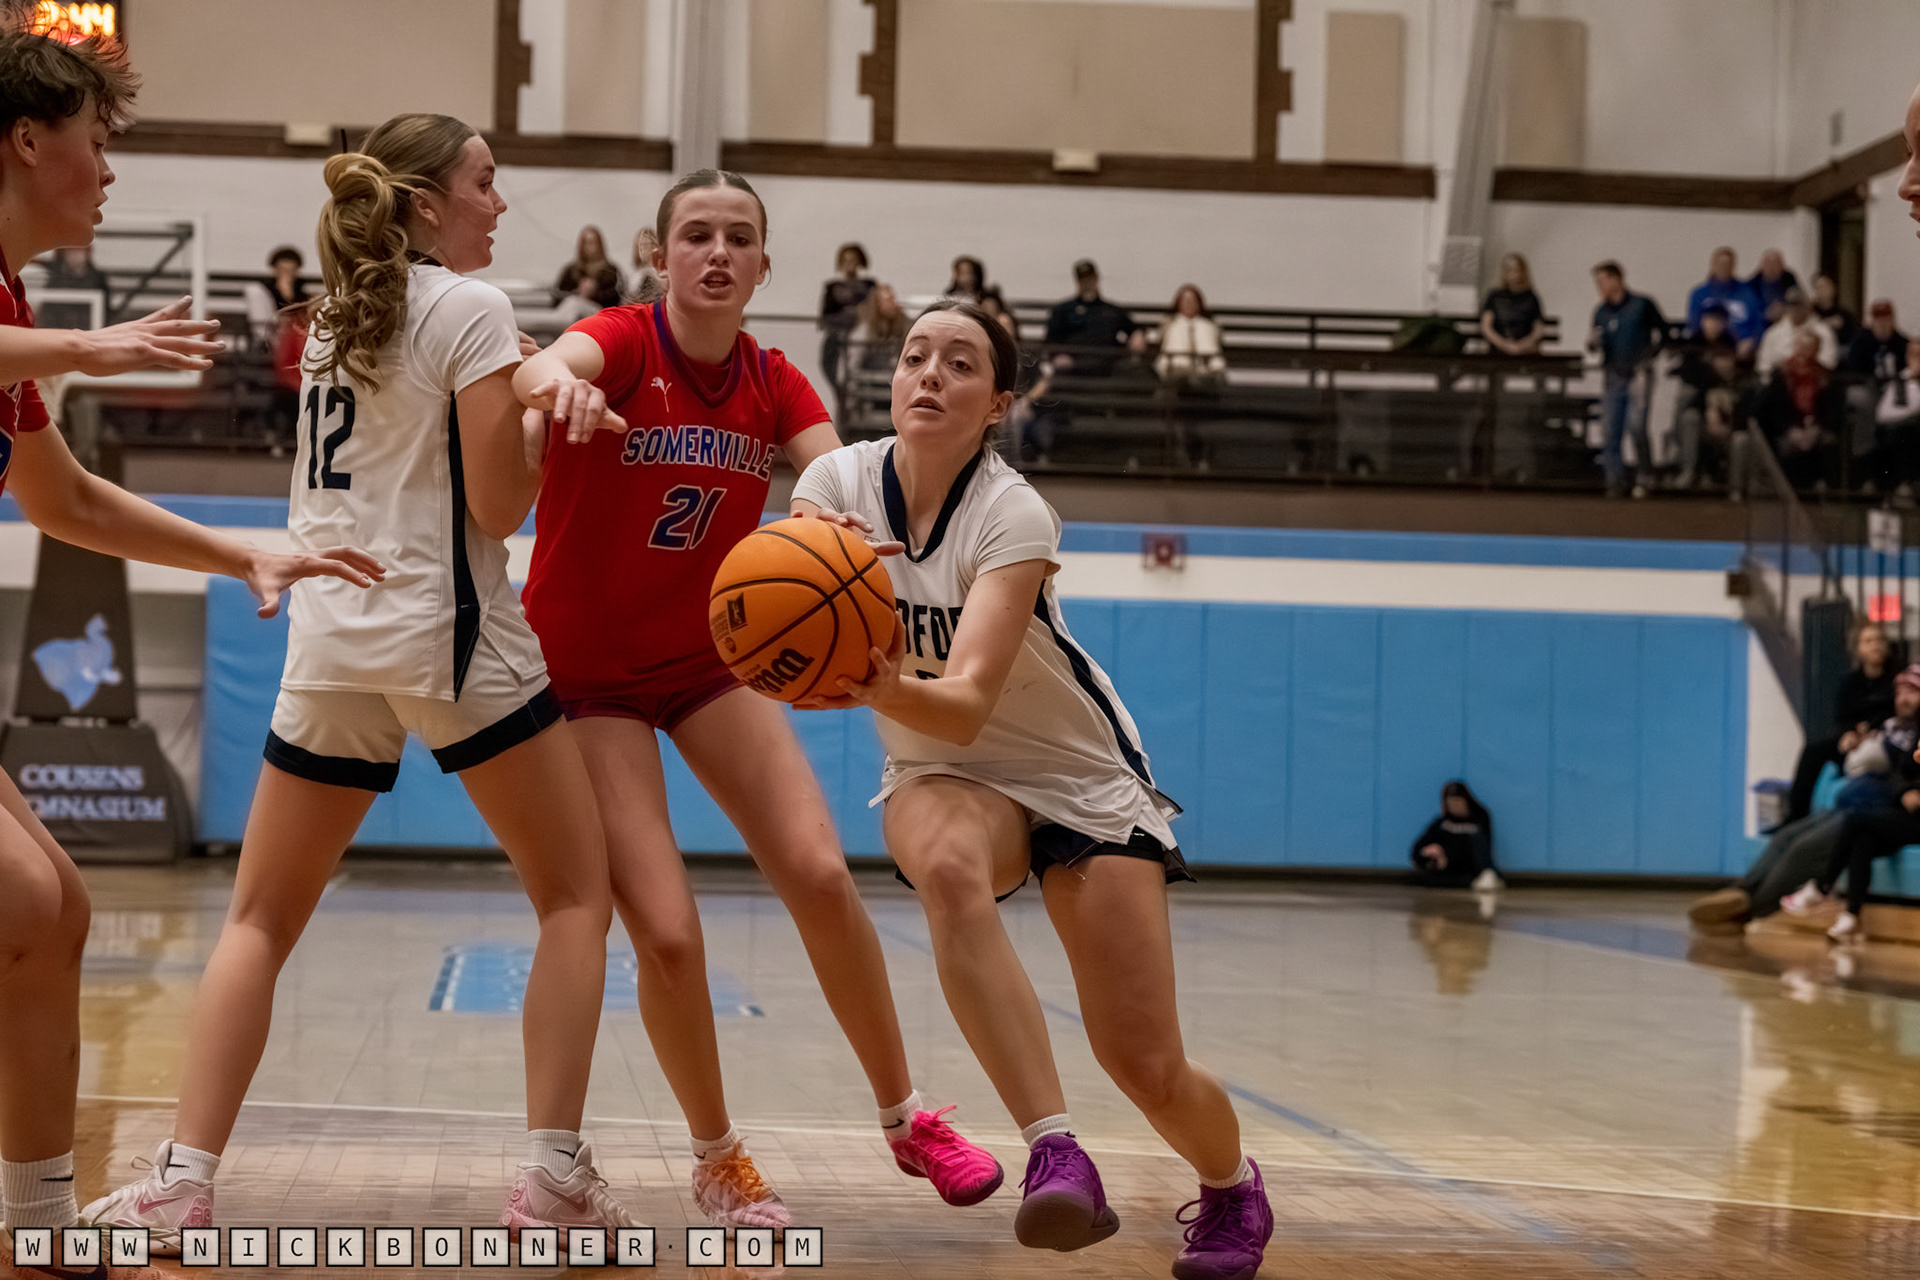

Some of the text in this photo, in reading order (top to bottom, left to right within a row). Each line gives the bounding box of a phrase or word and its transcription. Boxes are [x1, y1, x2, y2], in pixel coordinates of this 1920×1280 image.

[304, 385, 356, 490] 12
[621, 424, 776, 482] SOMERVILLE
[647, 484, 728, 551] 21
